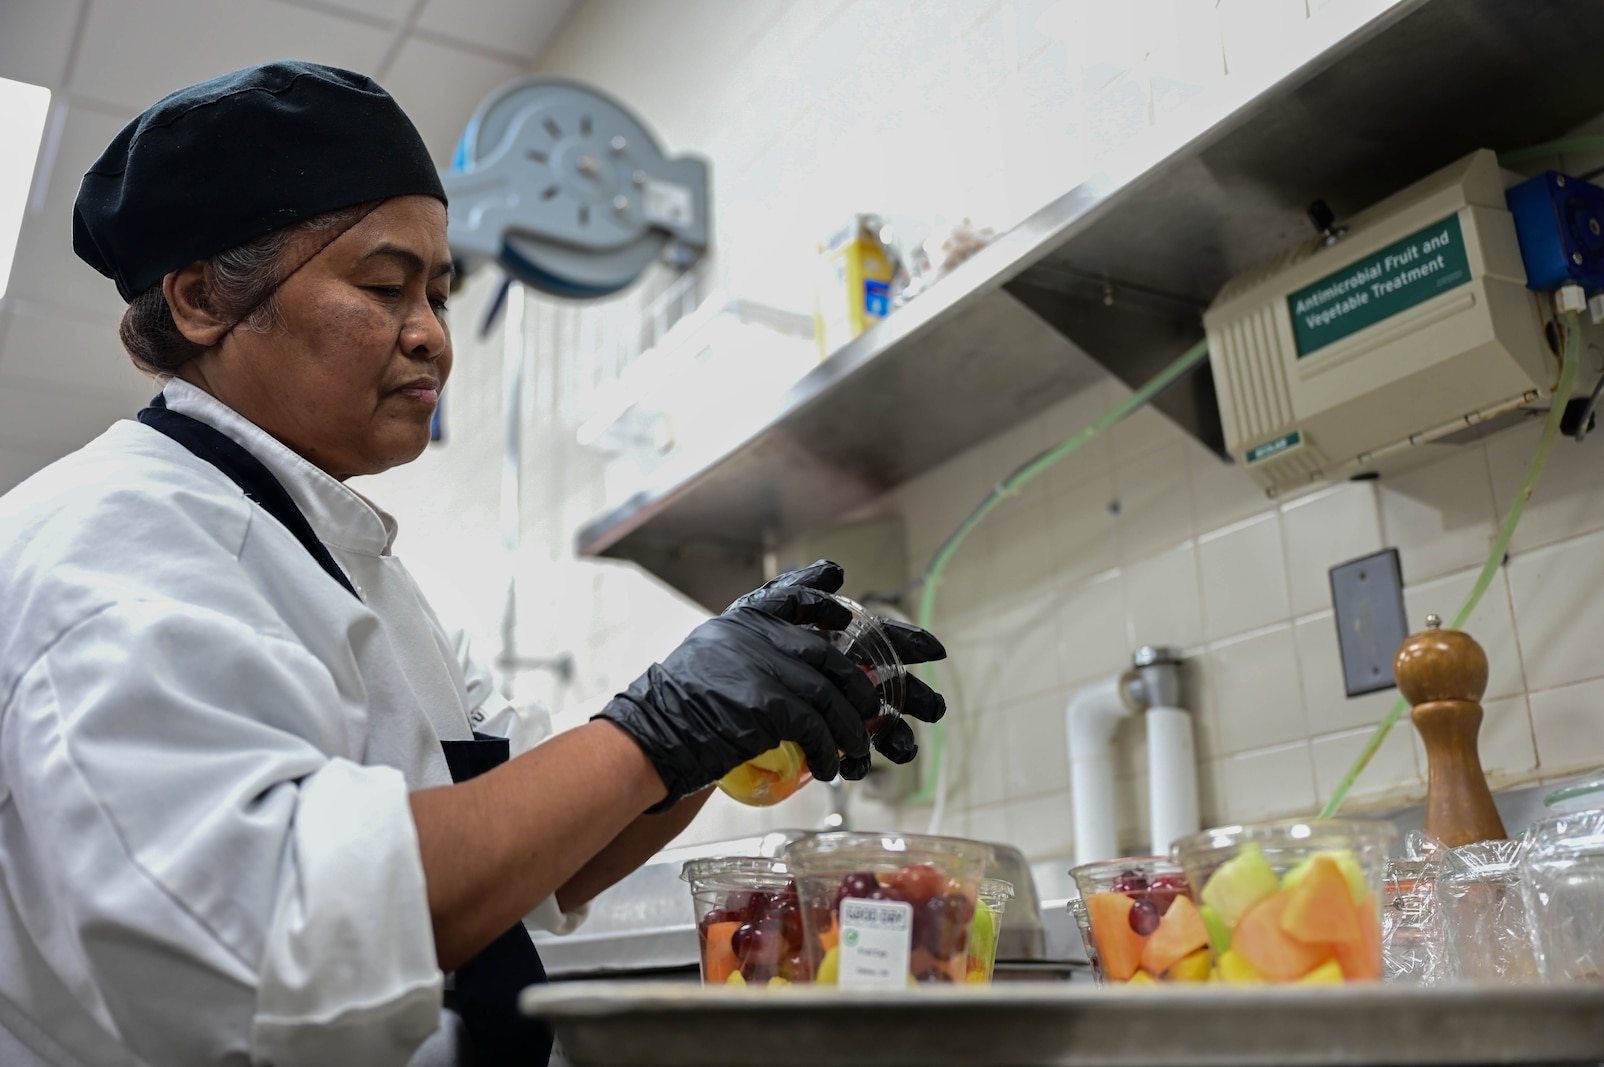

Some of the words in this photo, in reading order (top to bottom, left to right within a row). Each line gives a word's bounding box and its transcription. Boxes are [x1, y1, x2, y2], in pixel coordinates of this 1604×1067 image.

[1296, 261, 1382, 315] Antimicrobial
[1384, 245, 1419, 272] Fruit
[1423, 229, 1450, 254] and
[1305, 291, 1369, 329] Vegetable
[1371, 254, 1446, 299] Treatment
